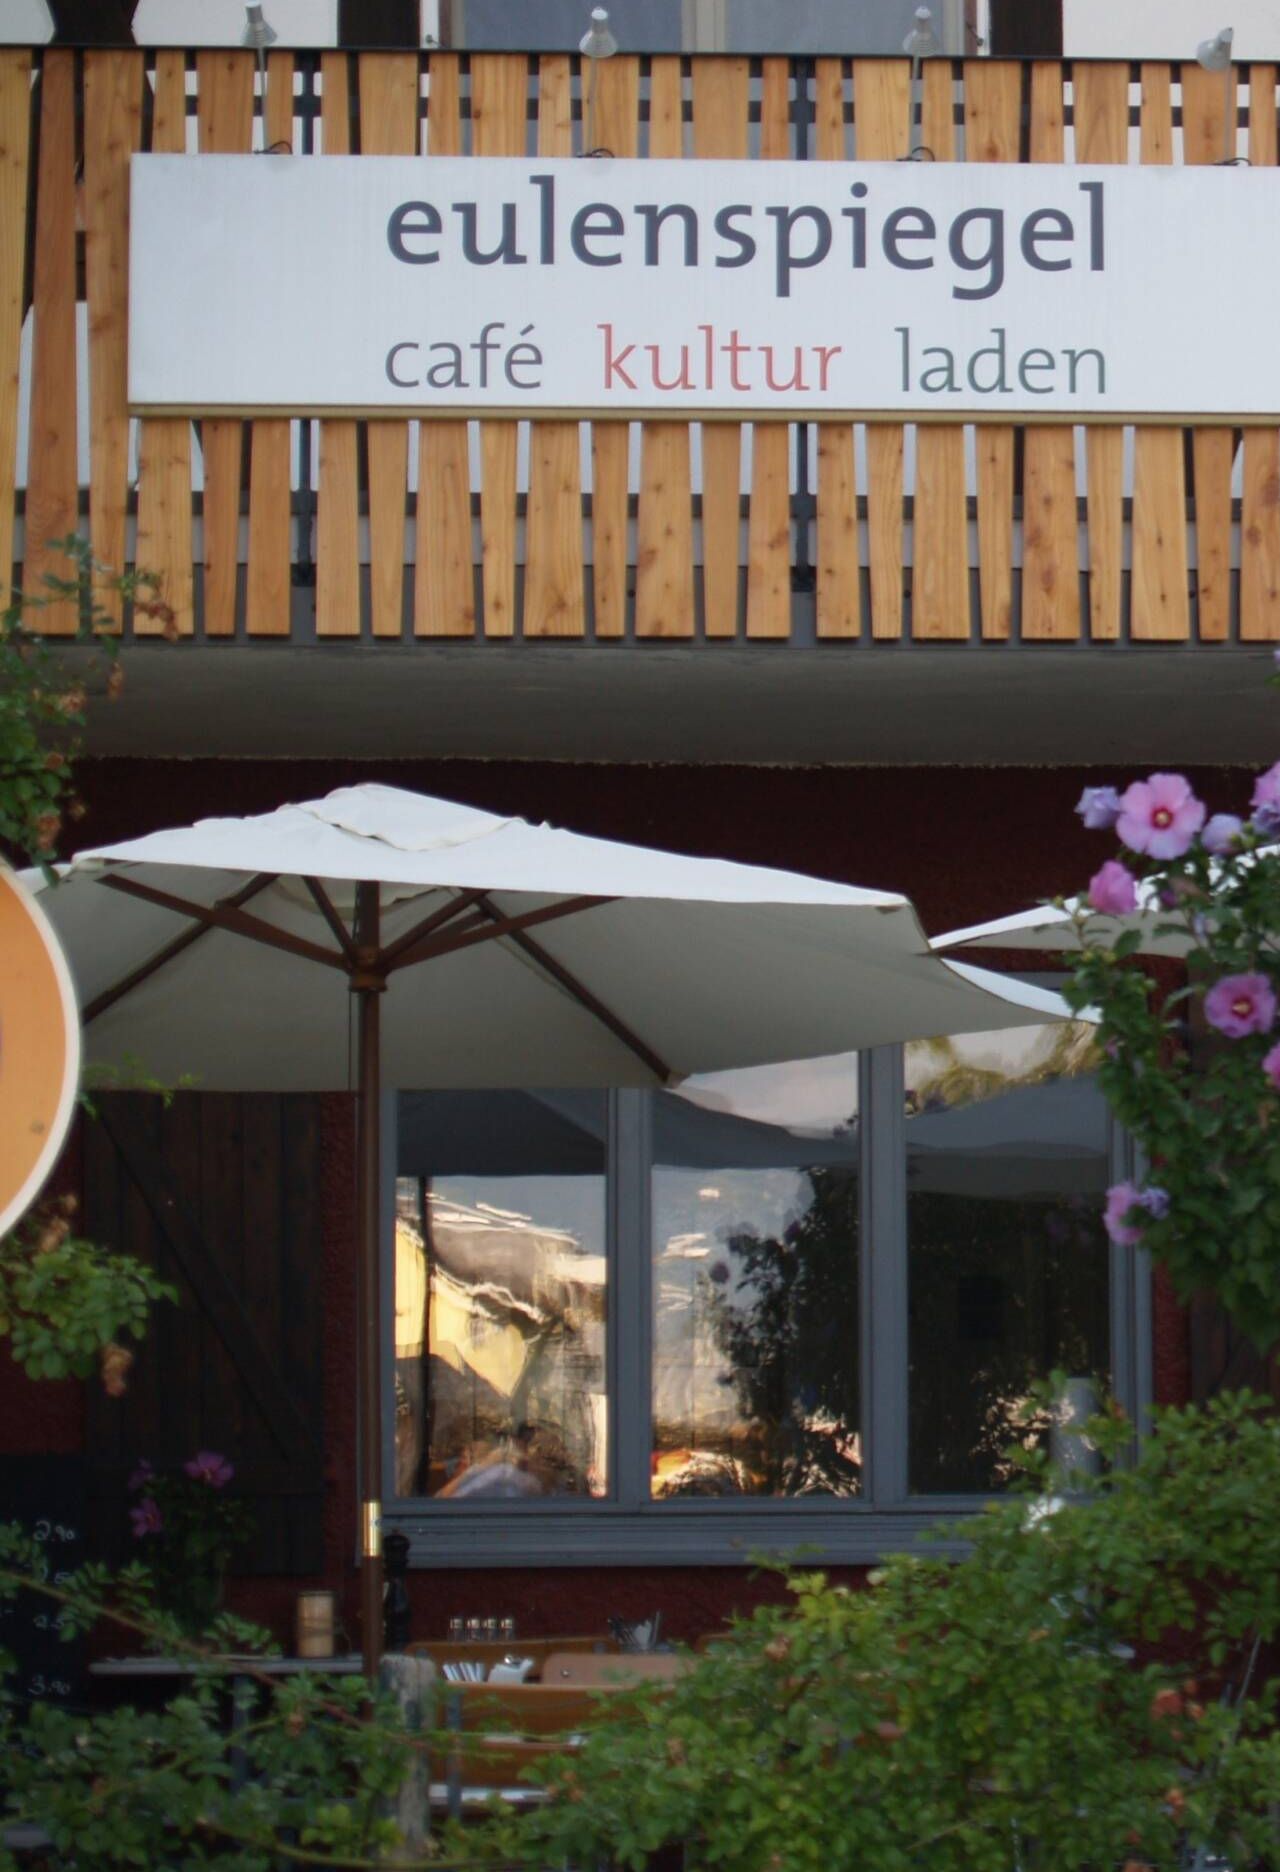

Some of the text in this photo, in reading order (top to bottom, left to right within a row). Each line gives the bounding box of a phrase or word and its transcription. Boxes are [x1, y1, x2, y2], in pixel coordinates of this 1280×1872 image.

[386, 174, 1106, 301] eulenspiegel
[385, 321, 1107, 394] café kultur laden
